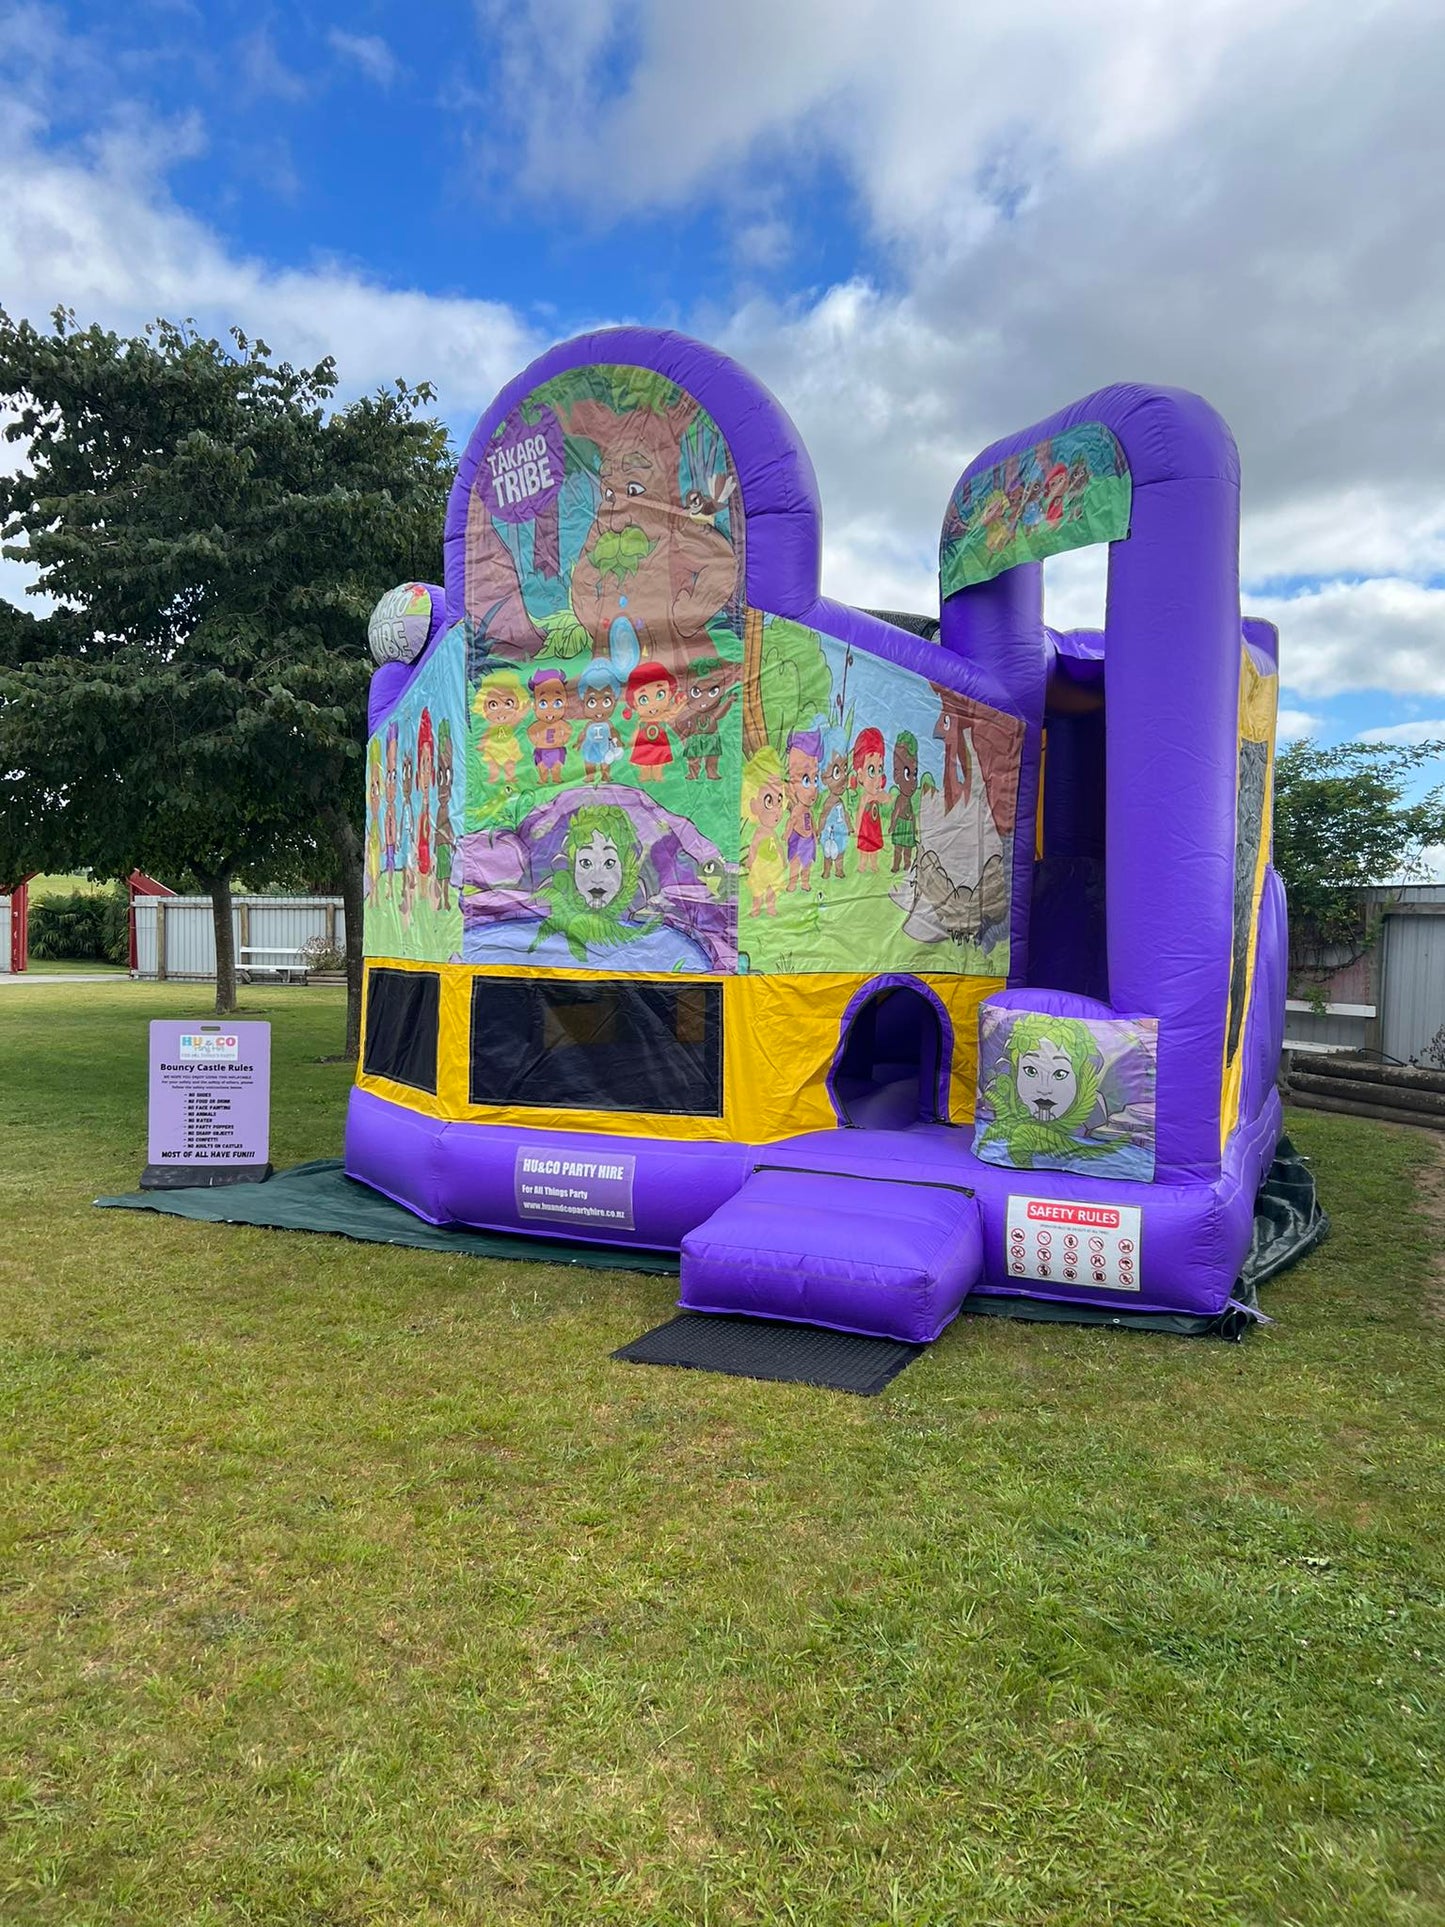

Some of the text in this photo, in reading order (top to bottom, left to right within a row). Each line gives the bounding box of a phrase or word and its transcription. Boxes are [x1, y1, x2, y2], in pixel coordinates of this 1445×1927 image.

[486, 434, 547, 477] TĀKARO
[492, 456, 554, 508] TRIBE
[546, 728, 556, 744] E
[594, 726, 604, 740] I
[646, 725, 659, 740] O
[182, 1036, 202, 1047] HU
[215, 1036, 236, 1047] CO
[160, 1064, 195, 1072] Bouncy
[523, 1158, 624, 1180] HU&CO PARTY HIRE
[522, 1184, 588, 1200] For All Things Party
[523, 1202, 625, 1218] www.huandcopartyhire.co.nz
[1030, 1205, 1118, 1224] SAFETY RULES
